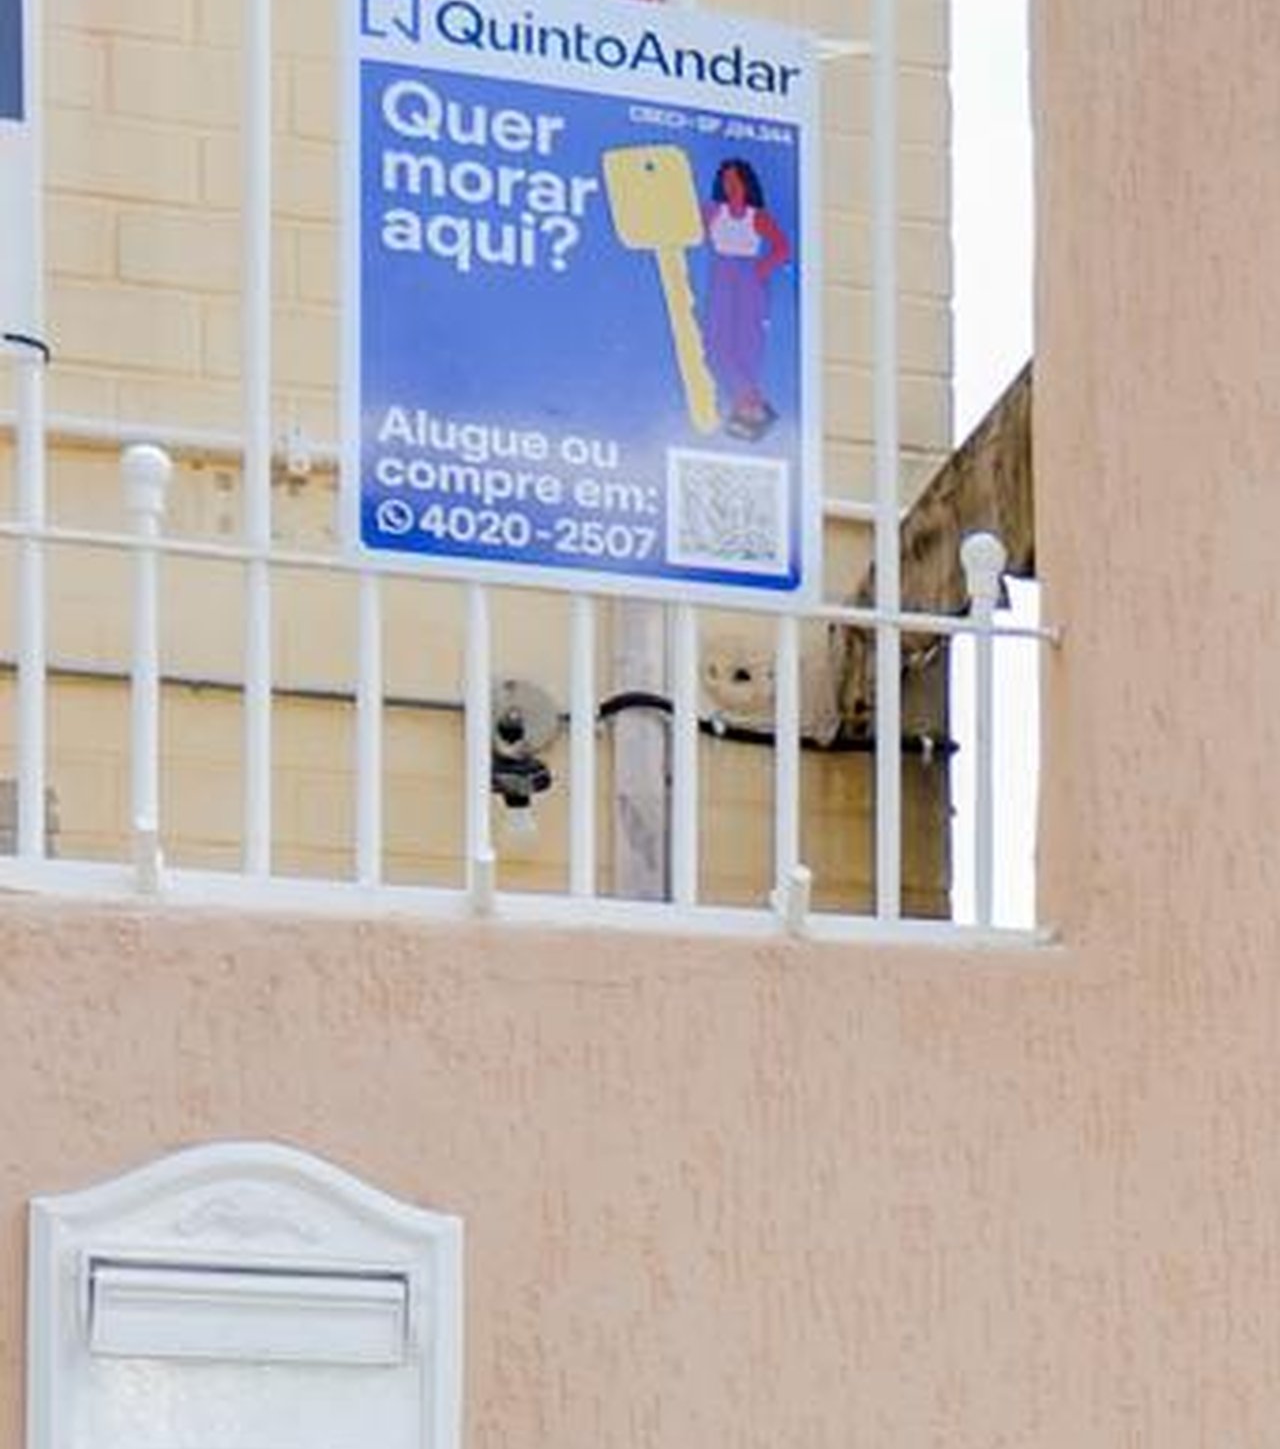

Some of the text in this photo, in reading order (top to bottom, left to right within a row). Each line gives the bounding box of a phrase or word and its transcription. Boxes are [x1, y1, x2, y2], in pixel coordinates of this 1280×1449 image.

[437, 0, 801, 96] QuintoAndar
[381, 80, 565, 156] Quer
[382, 149, 598, 217] morar
[381, 206, 580, 272] aqui?
[378, 405, 619, 469] Alugue ou
[375, 457, 660, 515] compre em:
[419, 504, 657, 560] 4020-2507
